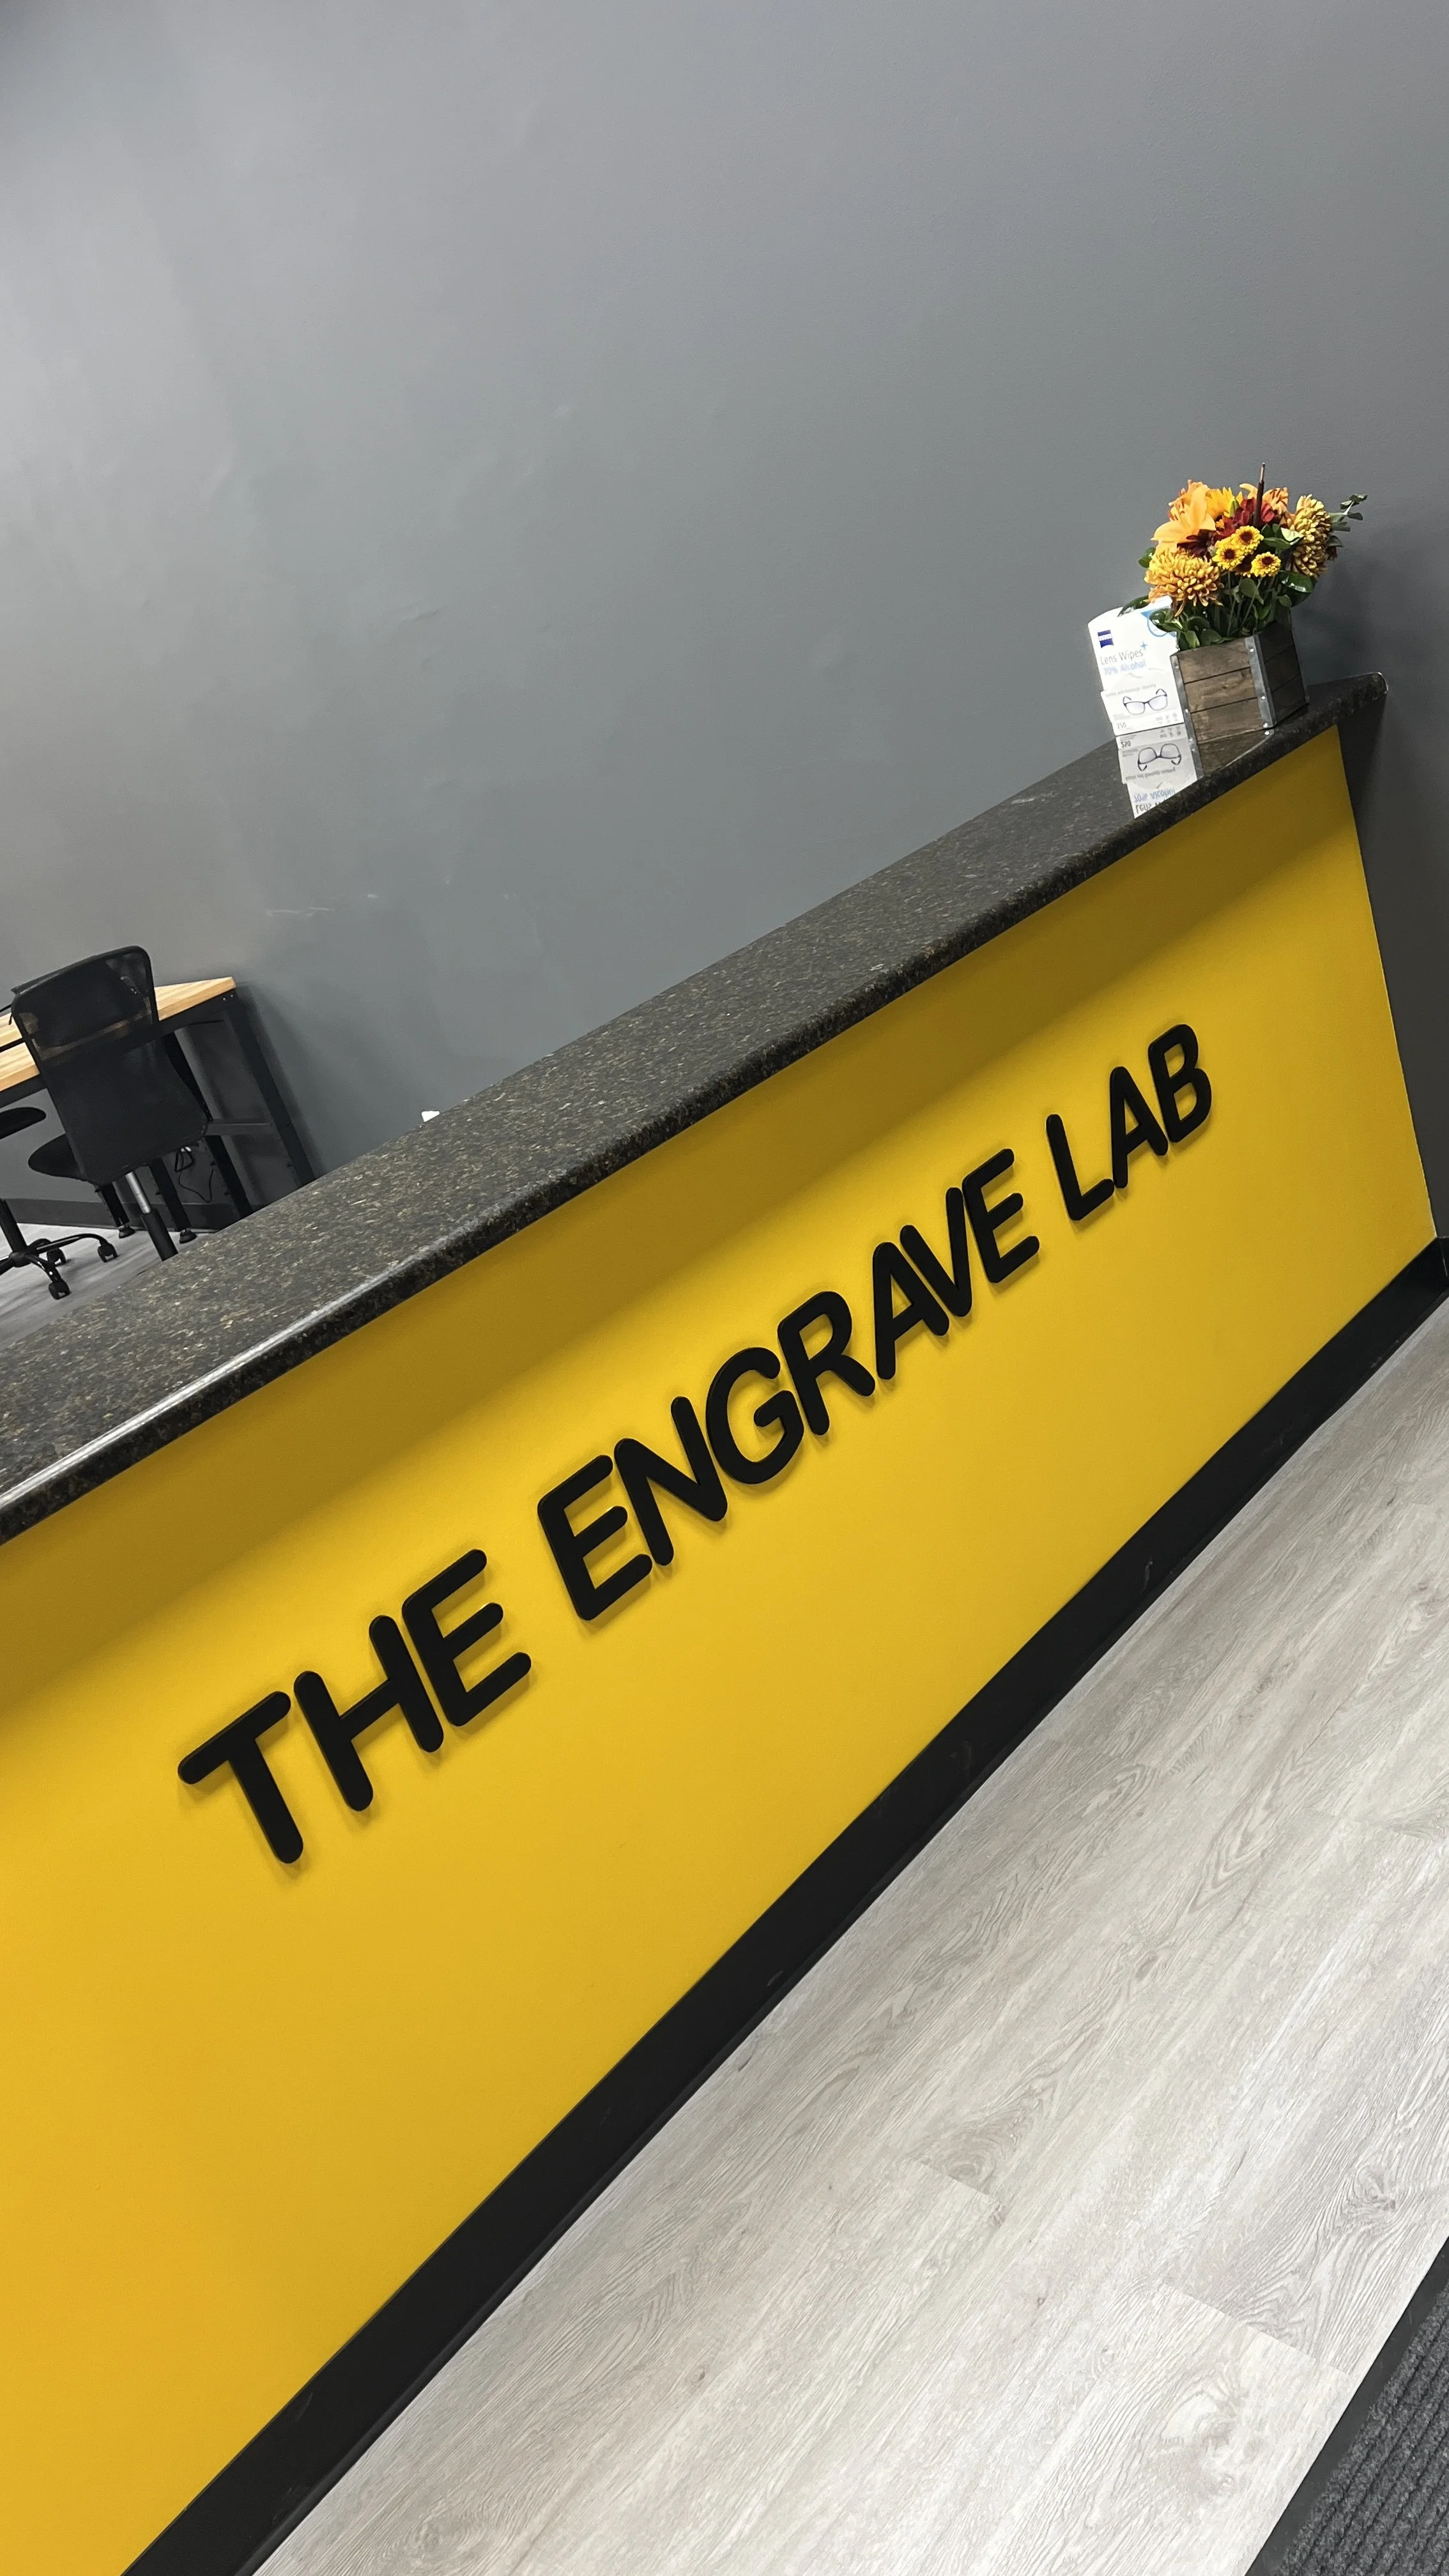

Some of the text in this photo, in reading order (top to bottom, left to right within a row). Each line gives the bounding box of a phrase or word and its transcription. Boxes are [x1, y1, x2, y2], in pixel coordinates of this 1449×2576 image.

[1100, 656, 1117, 665] Lens
[1103, 659, 1146, 675] 70% Alcohol
[178, 1024, 1212, 1864] THE ENGRAVE LAB
